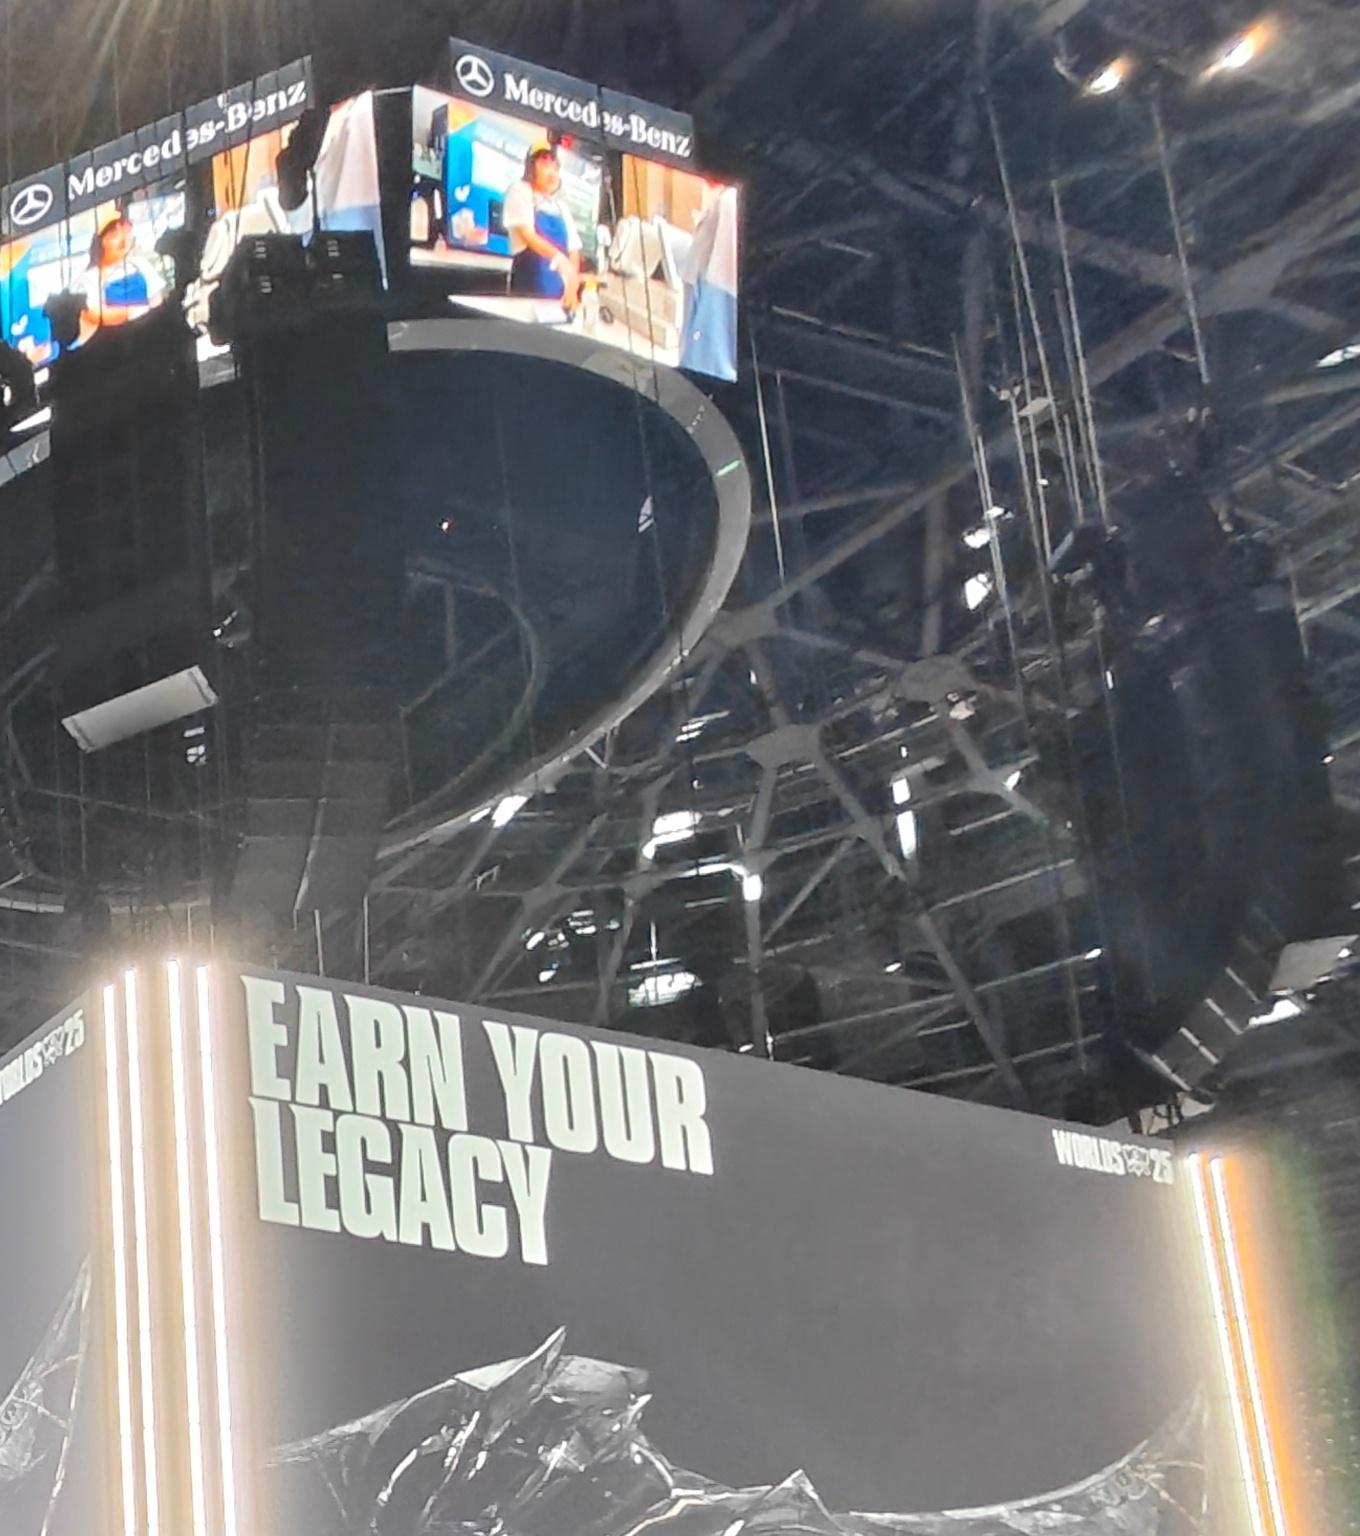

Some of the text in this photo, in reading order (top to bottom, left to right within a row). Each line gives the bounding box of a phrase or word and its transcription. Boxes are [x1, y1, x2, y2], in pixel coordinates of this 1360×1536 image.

[67, 78, 306, 198] Mercedes-Benz
[503, 70, 691, 159] Mercedes-Benz
[63, 1008, 85, 1056] 25
[240, 975, 714, 1175] EARN YOUR
[249, 1097, 552, 1265] LEGACY
[1052, 1129, 1174, 1185] WORLDS 25
